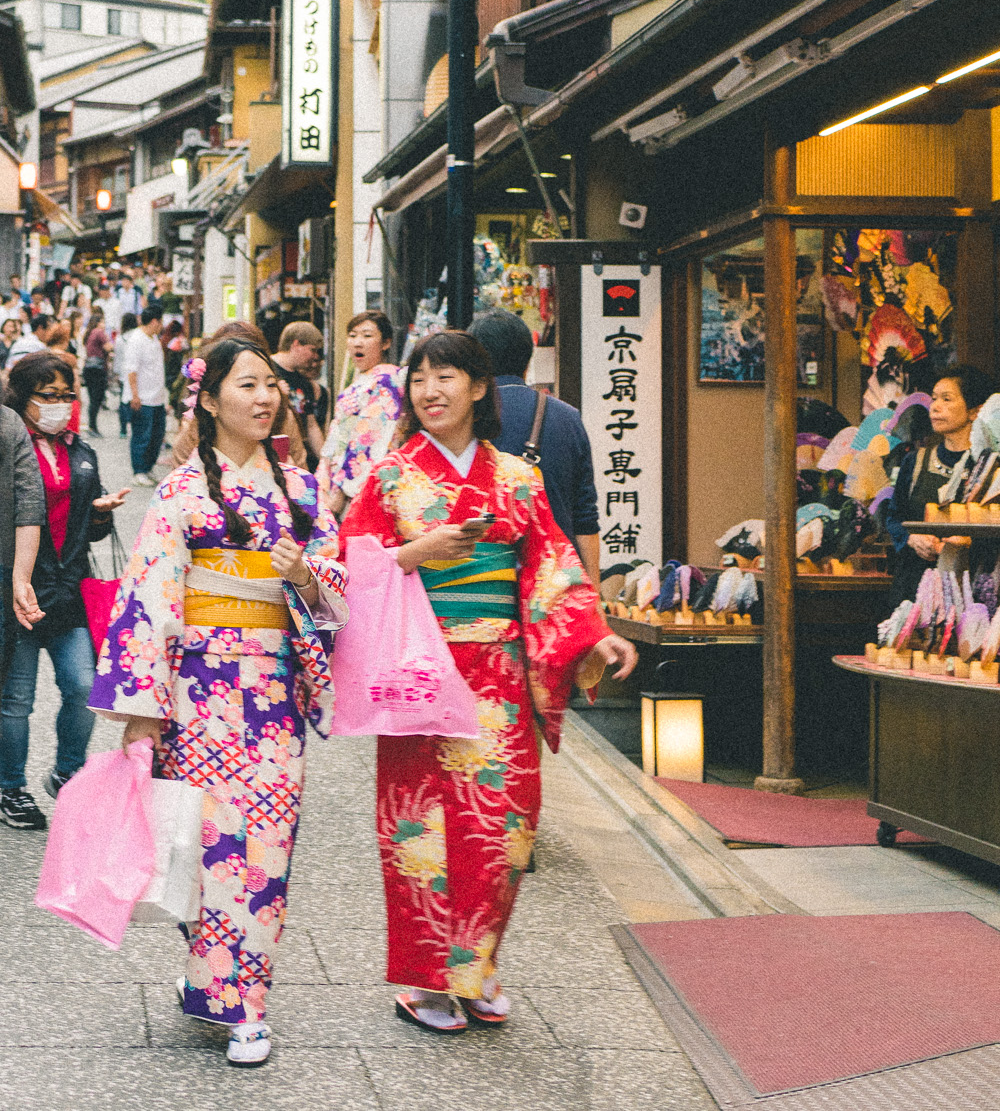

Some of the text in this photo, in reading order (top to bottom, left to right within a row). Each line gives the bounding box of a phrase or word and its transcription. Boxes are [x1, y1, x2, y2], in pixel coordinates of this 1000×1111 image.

[602, 325, 643, 555] 京扇子専門舗
